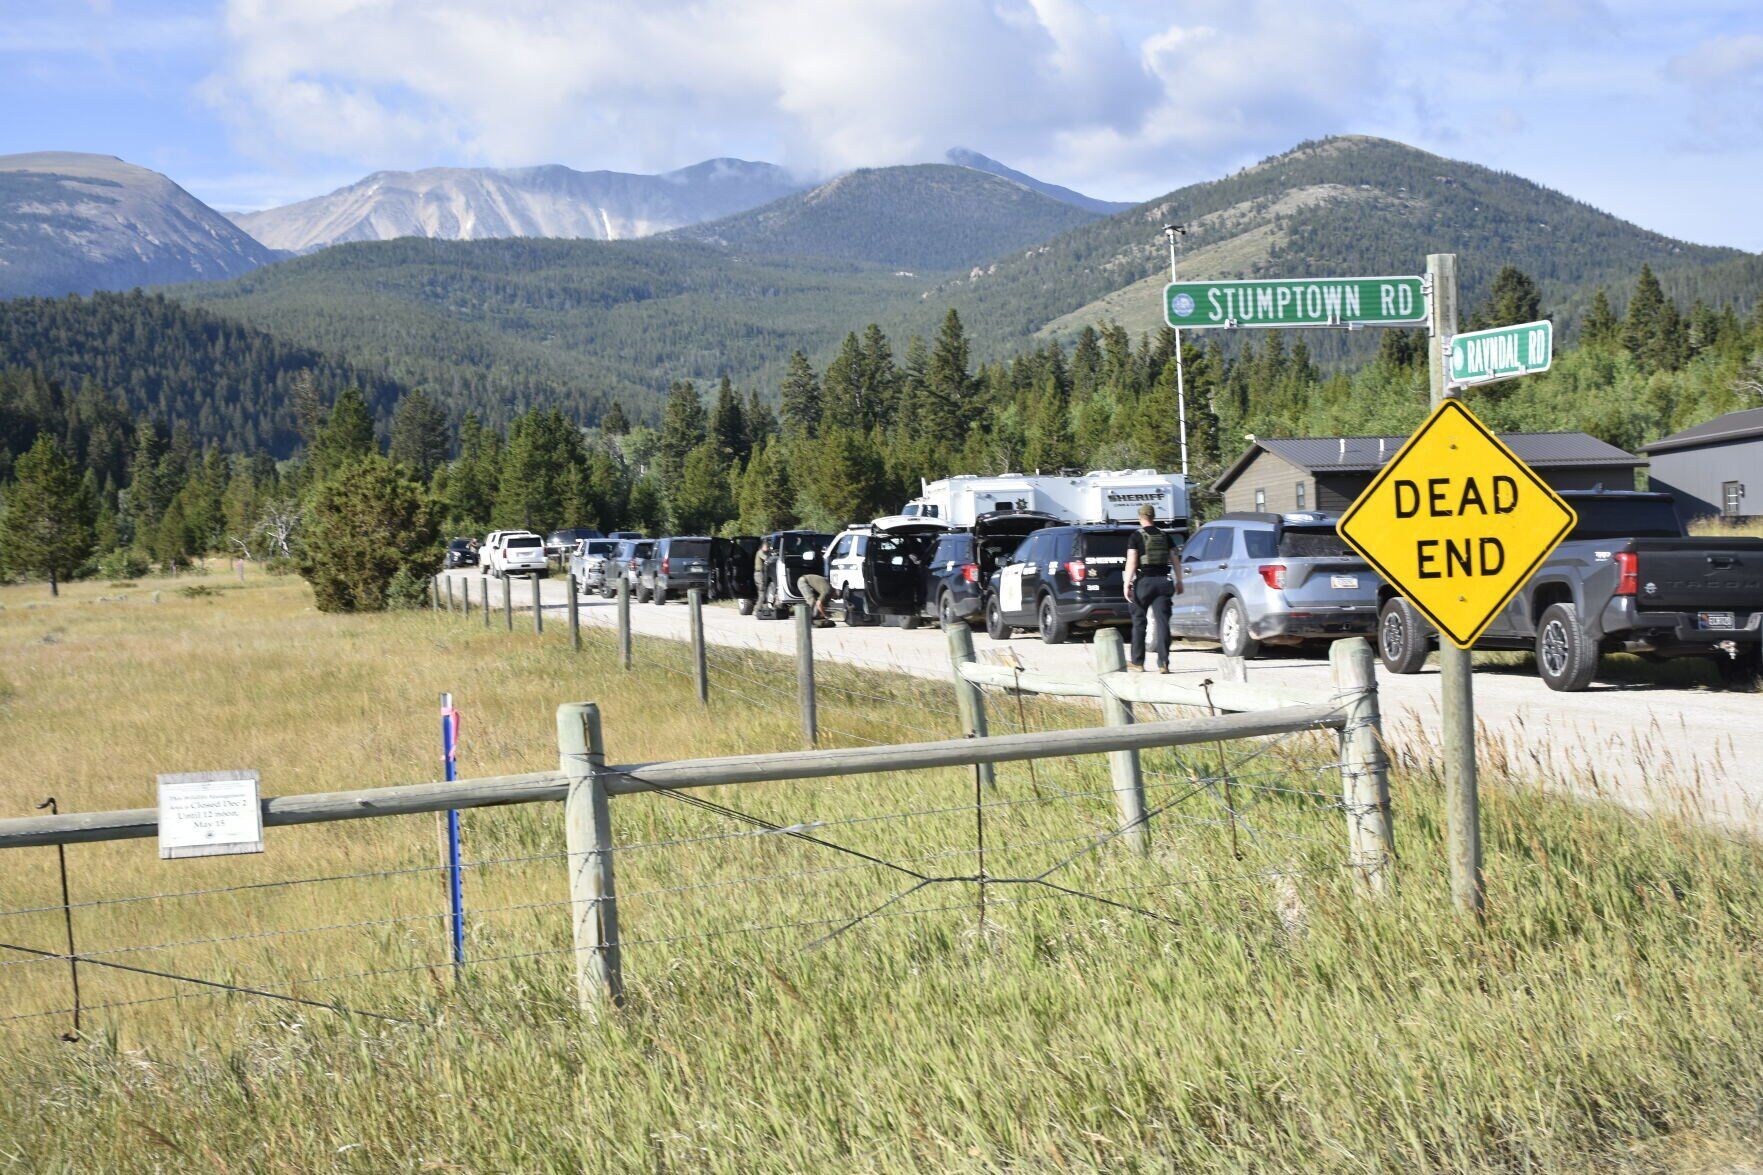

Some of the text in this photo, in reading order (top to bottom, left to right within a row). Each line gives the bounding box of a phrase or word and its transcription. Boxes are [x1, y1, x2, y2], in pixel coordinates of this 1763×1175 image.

[1207, 285, 1360, 321] STUMPTOWN
[1380, 283, 1413, 317] RD
[1528, 329, 1545, 365] RD
[1108, 493, 1165, 502] SHERIFF
[1394, 475, 1519, 580] DEAD END
